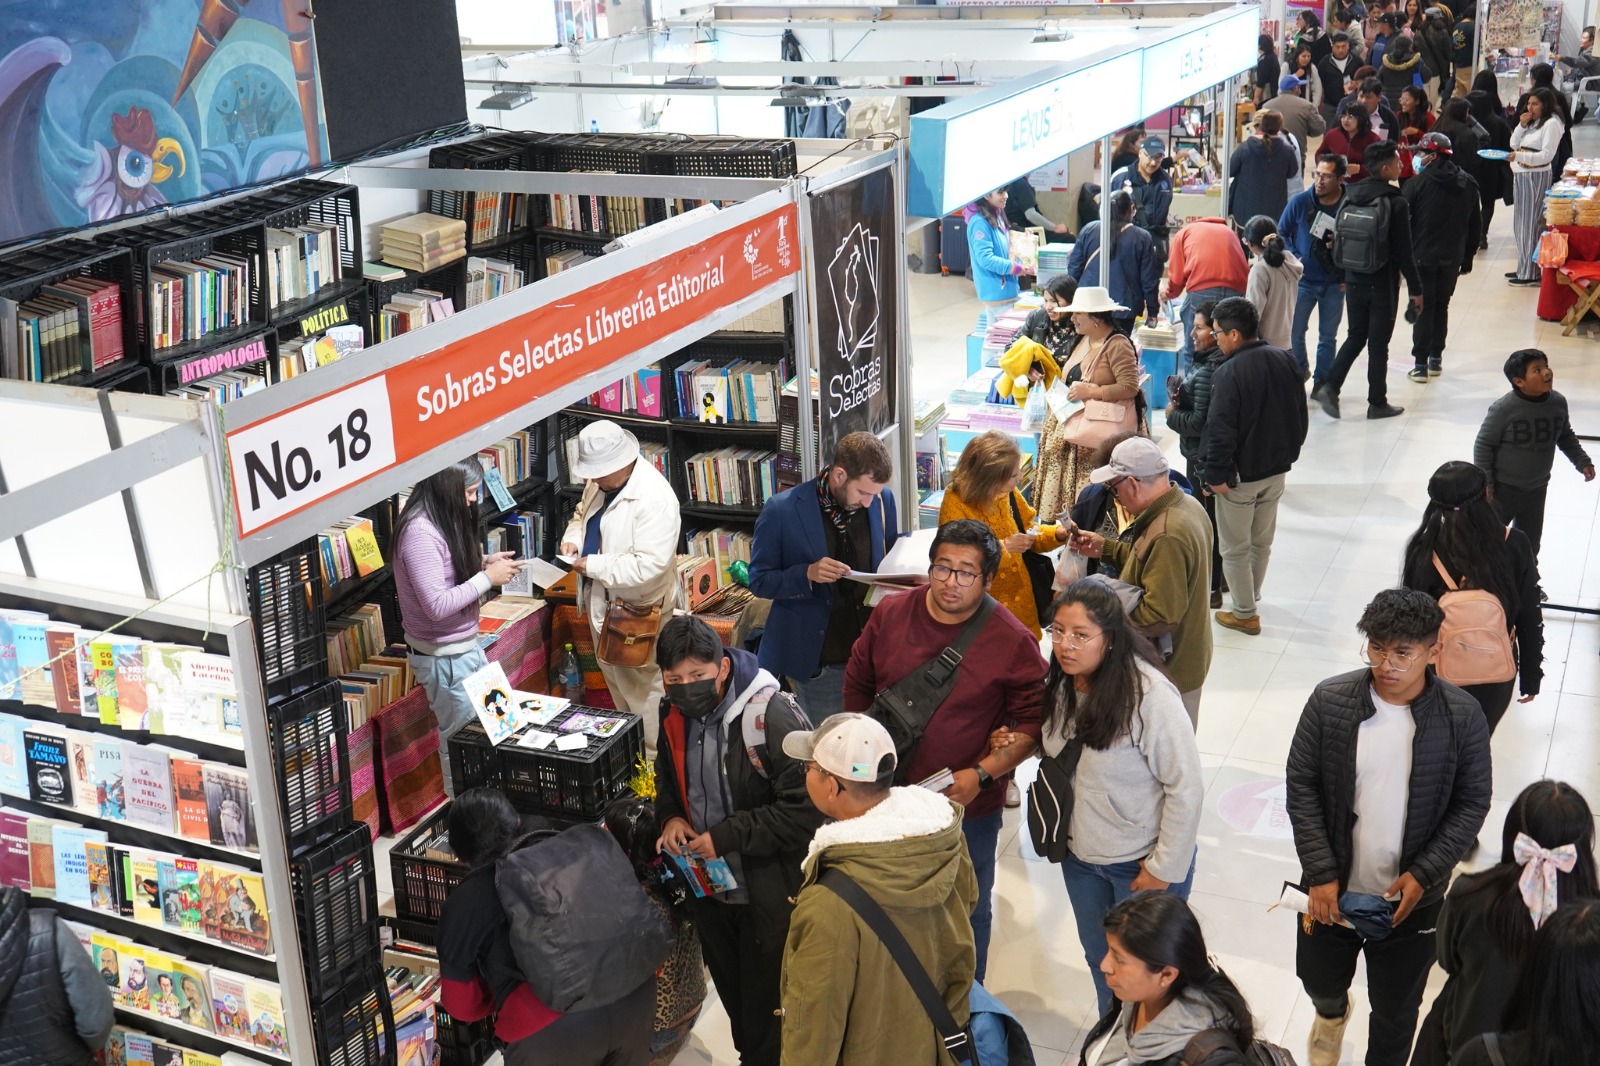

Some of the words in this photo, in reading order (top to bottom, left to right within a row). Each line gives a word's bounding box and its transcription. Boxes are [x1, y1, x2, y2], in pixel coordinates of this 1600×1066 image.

[1012, 106, 1051, 152] LEXUS
[301, 304, 348, 337] POLÍTICA
[416, 366, 497, 422] Sobras
[499, 328, 584, 385] Selectas
[585, 289, 657, 346] Librería
[657, 255, 726, 313] Editorial
[181, 340, 267, 384] ANTROPOLOGIA
[244, 440, 322, 512] No.
[327, 408, 372, 469] 18
[28, 750, 67, 765] TAMAYO
[34, 741, 60, 755] Franz
[131, 777, 163, 789] GUERRA
[141, 789, 156, 798] DEL
[183, 814, 202, 822] CIVIL
